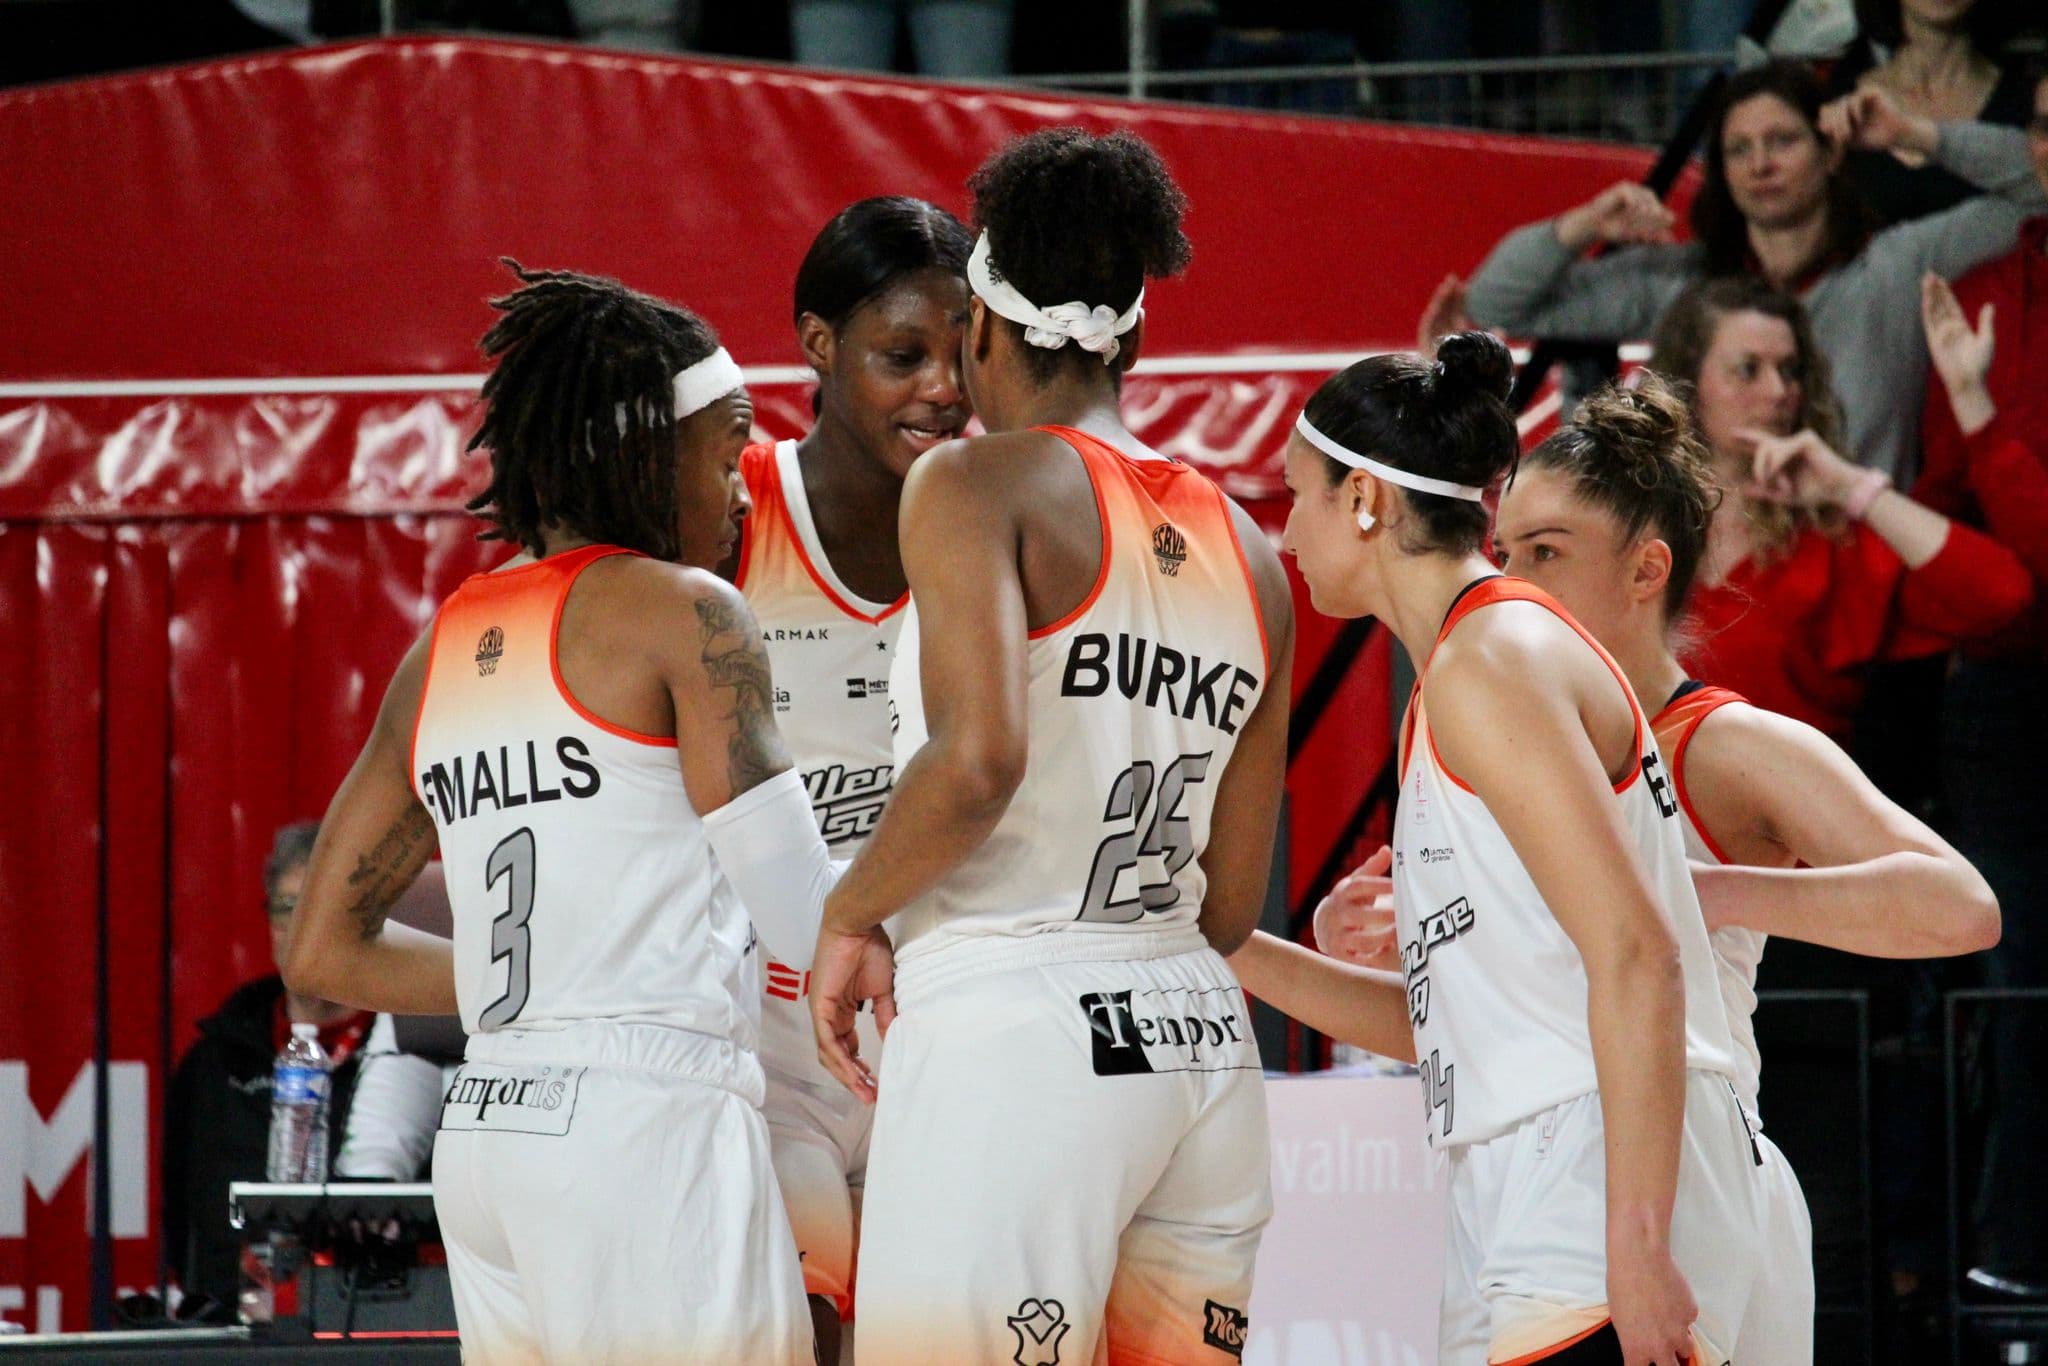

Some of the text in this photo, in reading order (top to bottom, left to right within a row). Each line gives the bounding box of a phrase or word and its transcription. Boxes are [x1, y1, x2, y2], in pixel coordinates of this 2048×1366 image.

[1061, 633, 1258, 737] BURKE
[1076, 751, 1213, 924] 25
[479, 826, 537, 1033] 3
